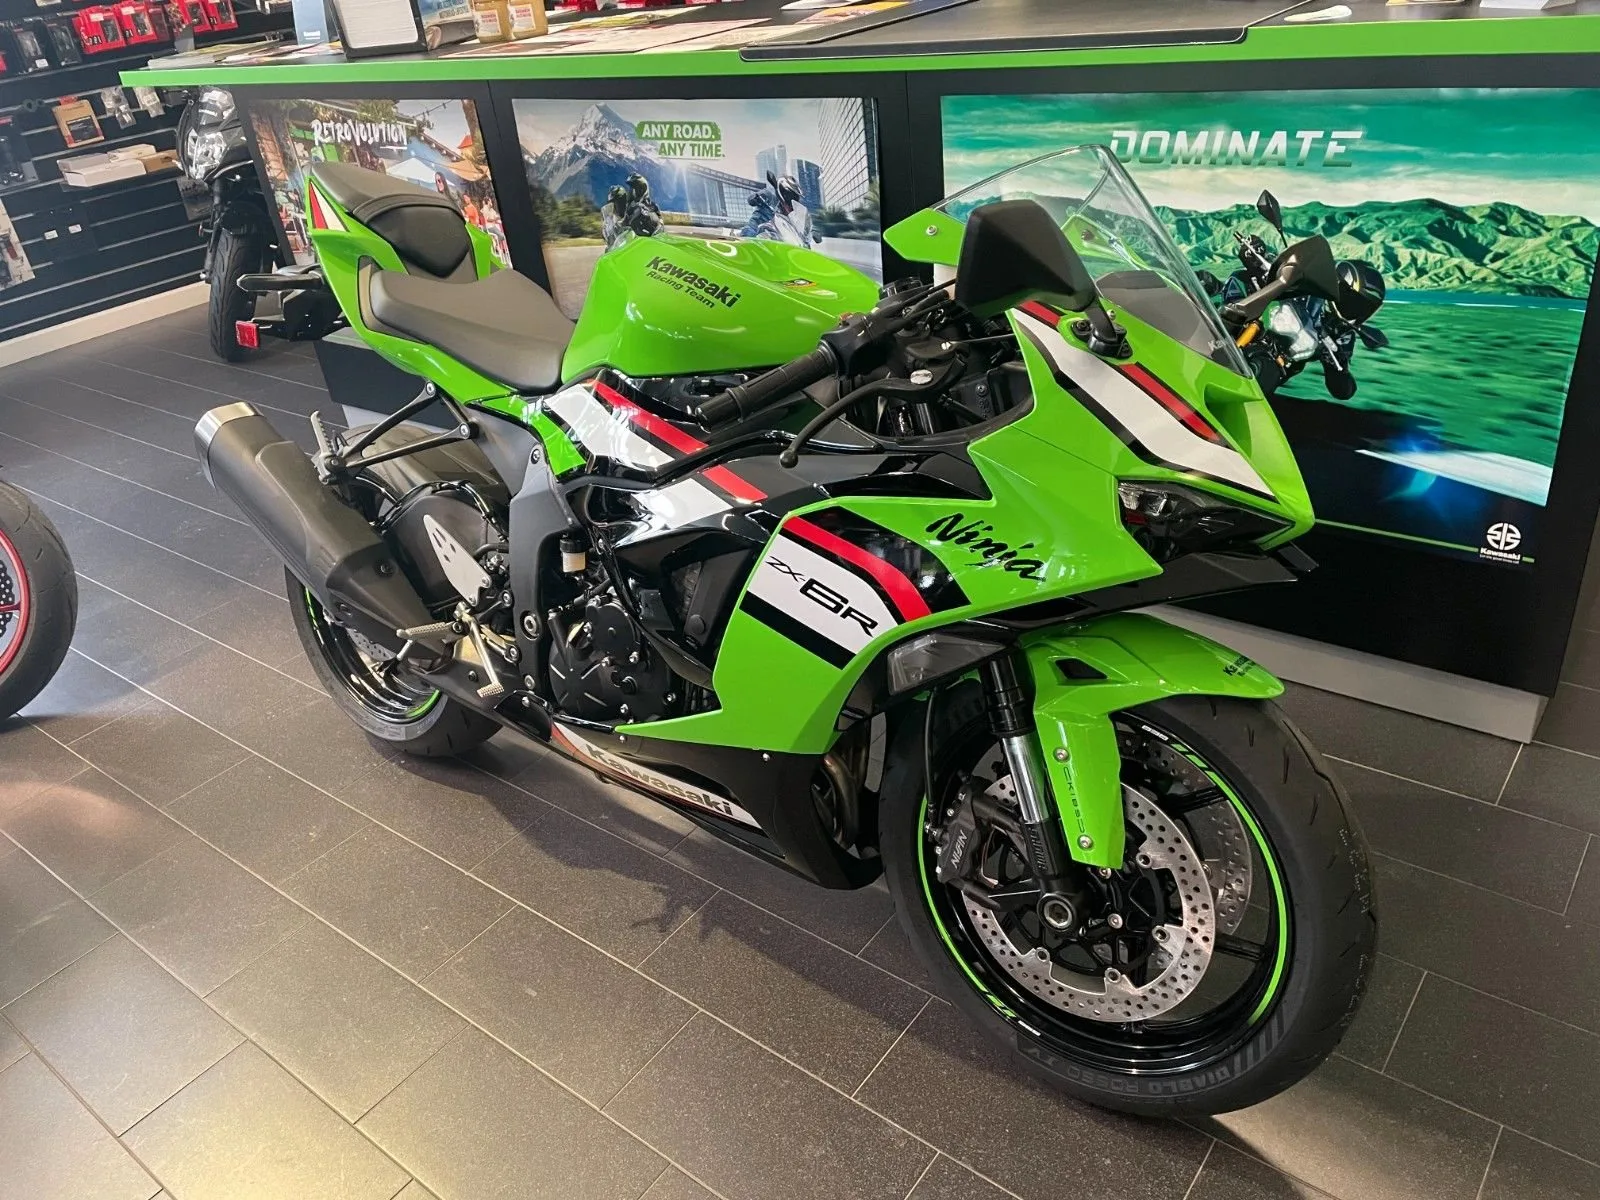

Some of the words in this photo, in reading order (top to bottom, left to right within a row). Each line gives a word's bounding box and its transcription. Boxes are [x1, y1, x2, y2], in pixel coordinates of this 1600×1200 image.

[642, 123, 670, 138] ANY
[673, 124, 715, 139] ROAD.
[658, 142, 686, 156] ANY
[689, 143, 726, 158] TIME.
[1110, 130, 1362, 167] DOMINATE
[645, 256, 741, 308] Kawasaki
[646, 271, 683, 291] Racing
[685, 287, 716, 309] Team
[925, 512, 1047, 583] Ninja
[765, 555, 878, 638] ZX-6R
[585, 743, 734, 817] Kawasaki
